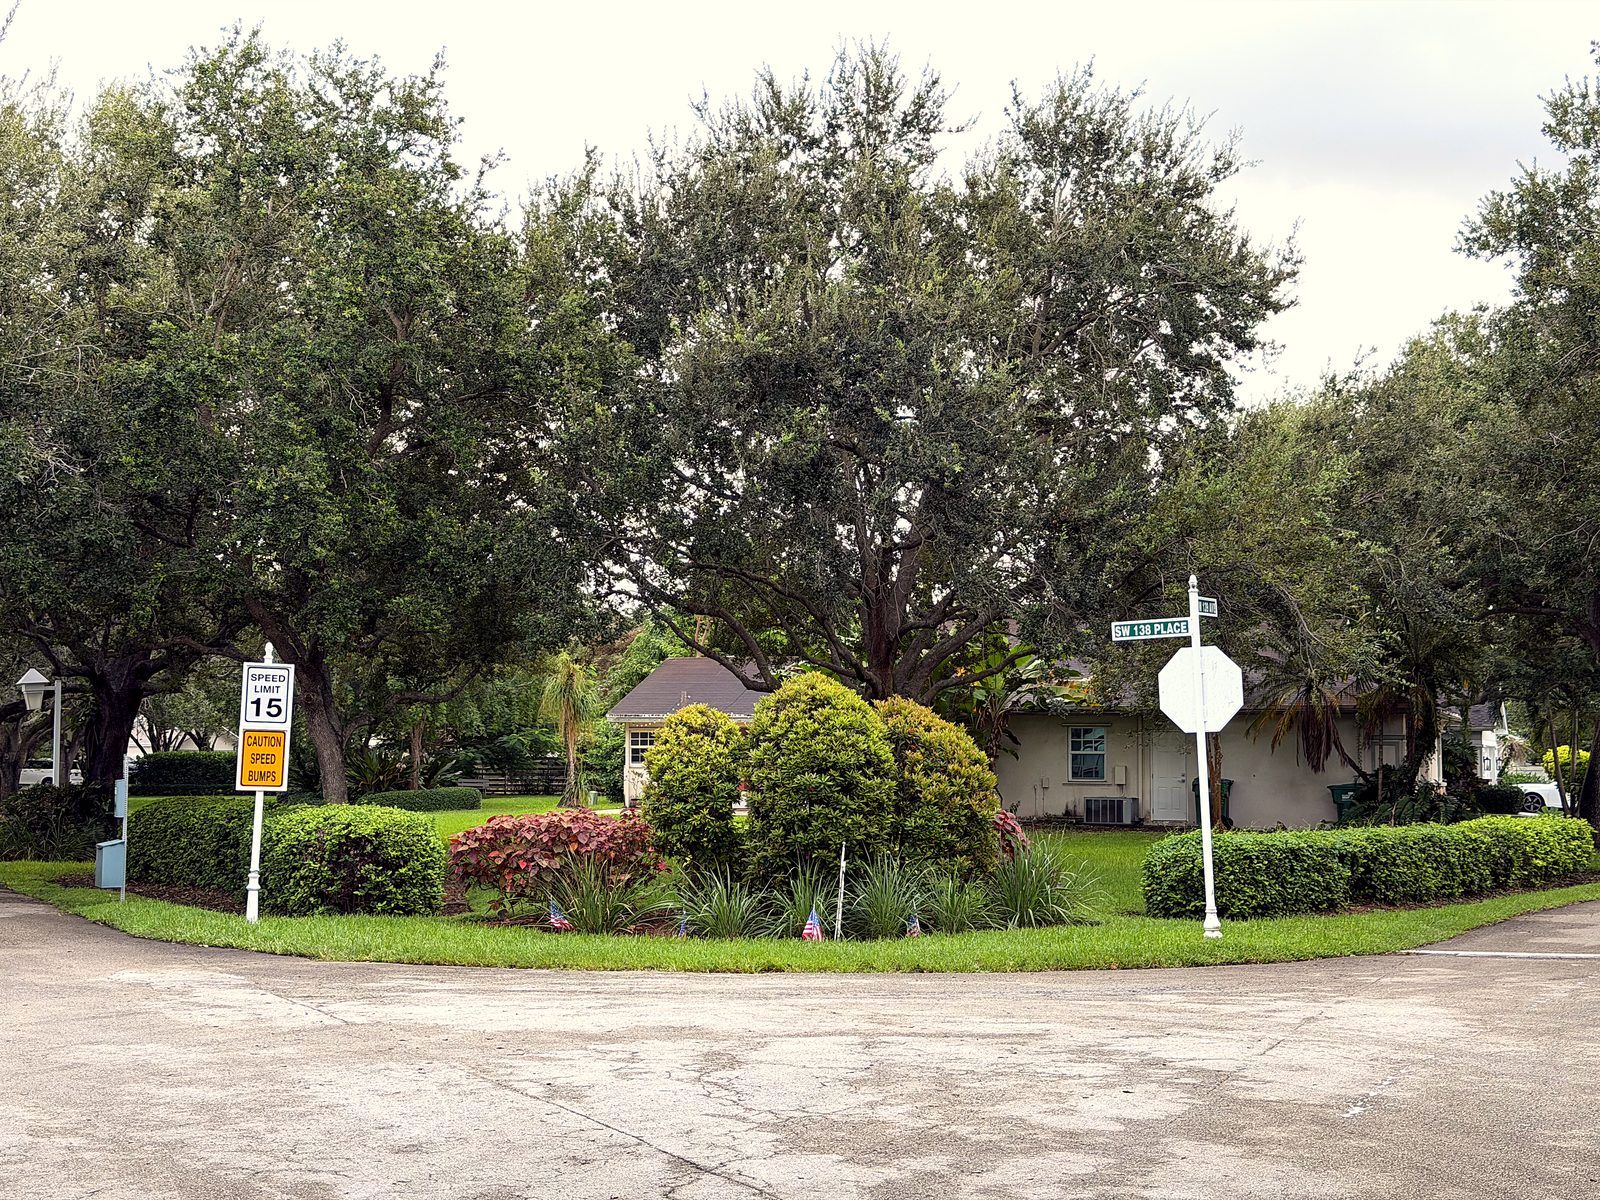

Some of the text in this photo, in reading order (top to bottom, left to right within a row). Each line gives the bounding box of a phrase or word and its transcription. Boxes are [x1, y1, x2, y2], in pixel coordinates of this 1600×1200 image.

[1115, 622, 1187, 637] SW 138 PLACE
[251, 674, 286, 682] SPEED
[254, 685, 281, 694] LIMIT
[250, 697, 282, 718] 15
[247, 736, 282, 747] CAUTION
[250, 753, 276, 765] SPEED
[248, 770, 277, 782] BUMPS
